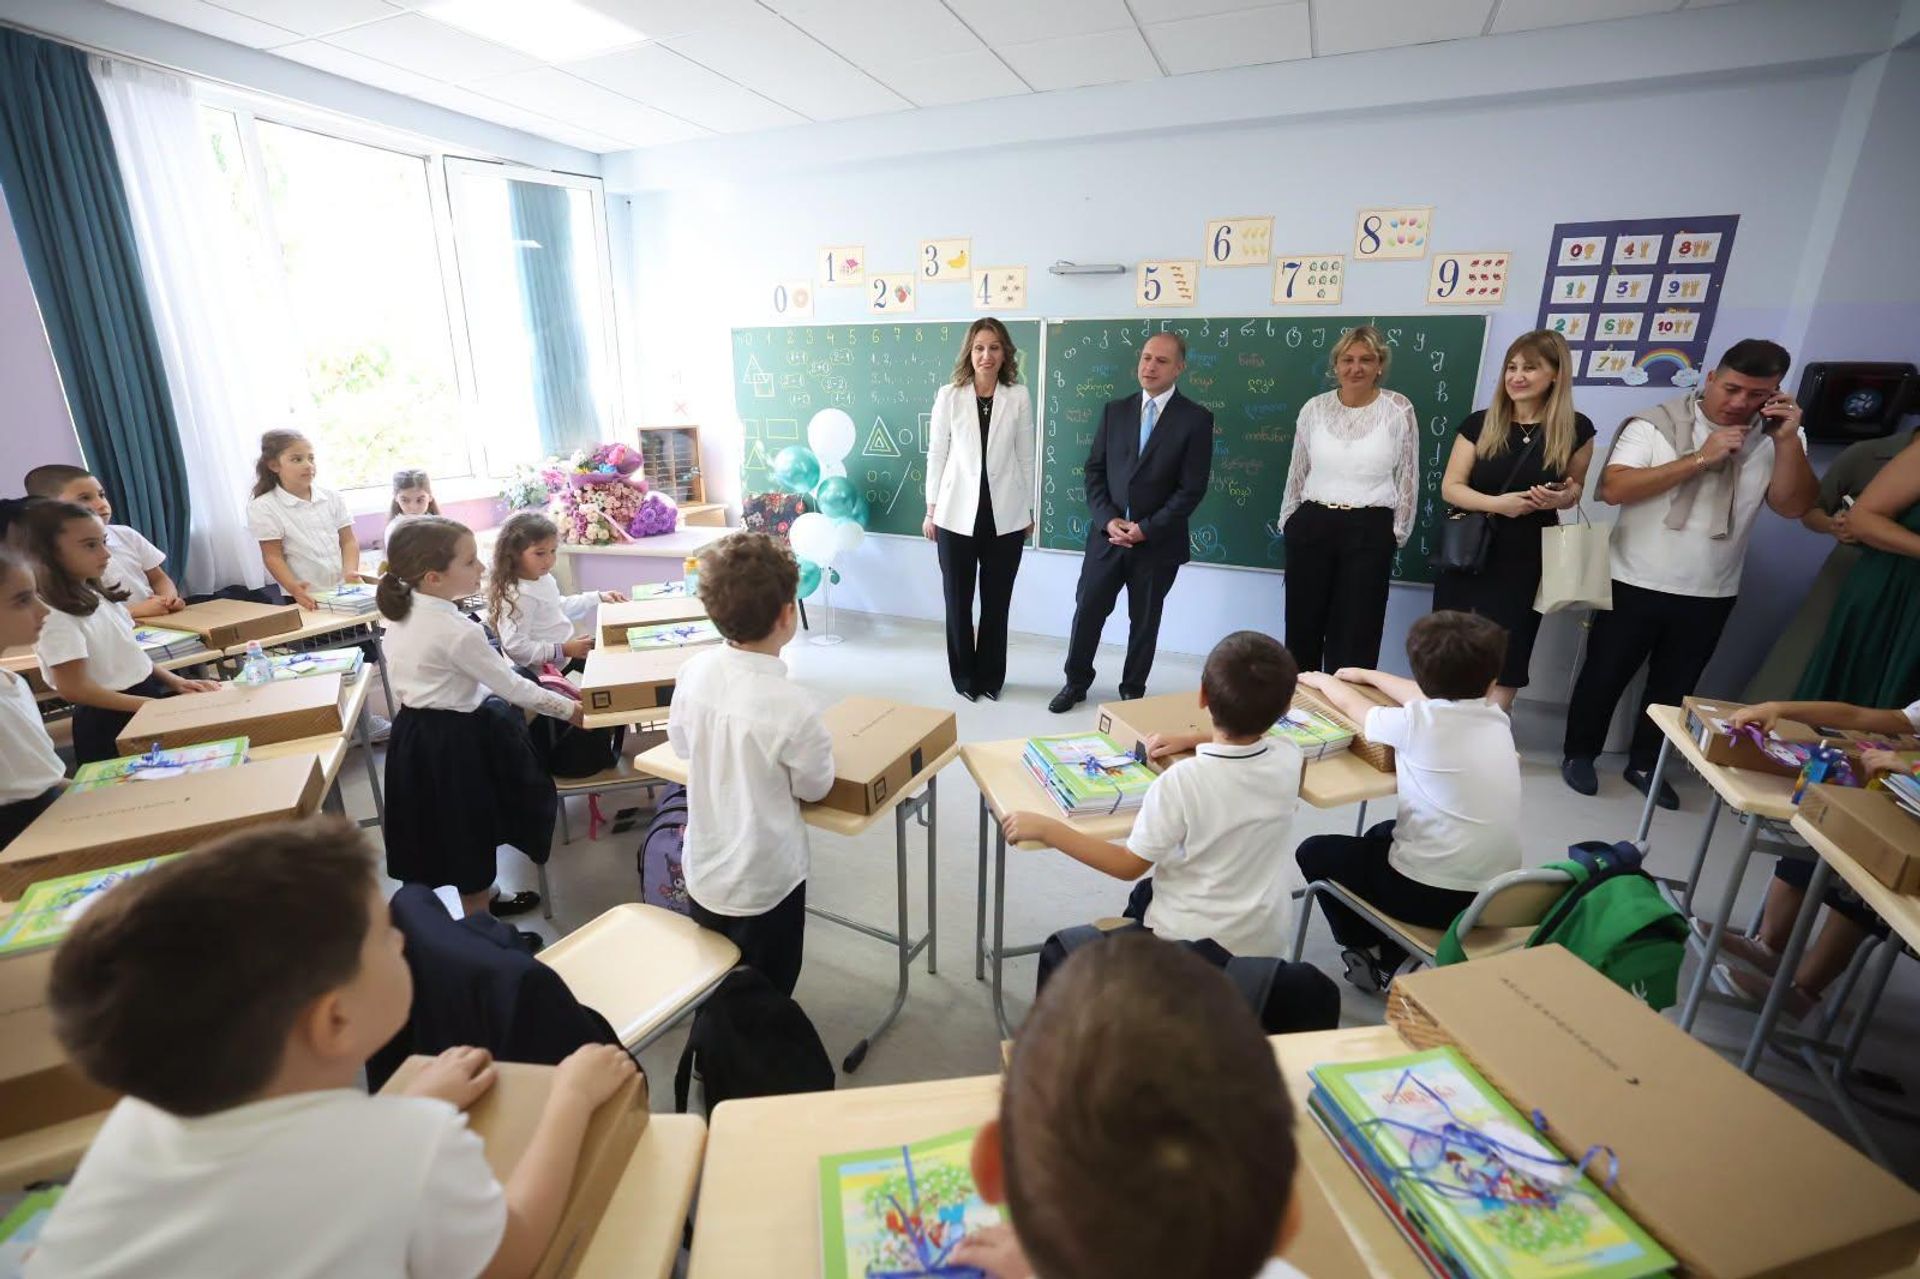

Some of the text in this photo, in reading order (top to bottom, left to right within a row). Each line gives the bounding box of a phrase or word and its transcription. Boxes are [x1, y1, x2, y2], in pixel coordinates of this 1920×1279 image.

[1360, 215, 1382, 254] 8
[1213, 225, 1231, 261] 6
[1570, 243, 1583, 257] 0
[1624, 241, 1635, 256] 4
[1679, 241, 1692, 255] 8
[826, 252, 835, 282] 1
[925, 245, 939, 277] 3
[1144, 266, 1161, 301] 5
[1282, 261, 1302, 298] 7
[1437, 259, 1459, 297] 9
[873, 279, 887, 309] 2
[977, 273, 992, 305] 4
[1566, 281, 1575, 296] 1
[1616, 281, 1629, 294] 5
[1668, 280, 1680, 293] 9
[774, 285, 787, 313] 0
[1555, 318, 1566, 332] 2
[1604, 319, 1615, 332] 6
[1657, 321, 1673, 332] 10
[940, 326, 948, 341] 9
[1599, 356, 1610, 368] 7
